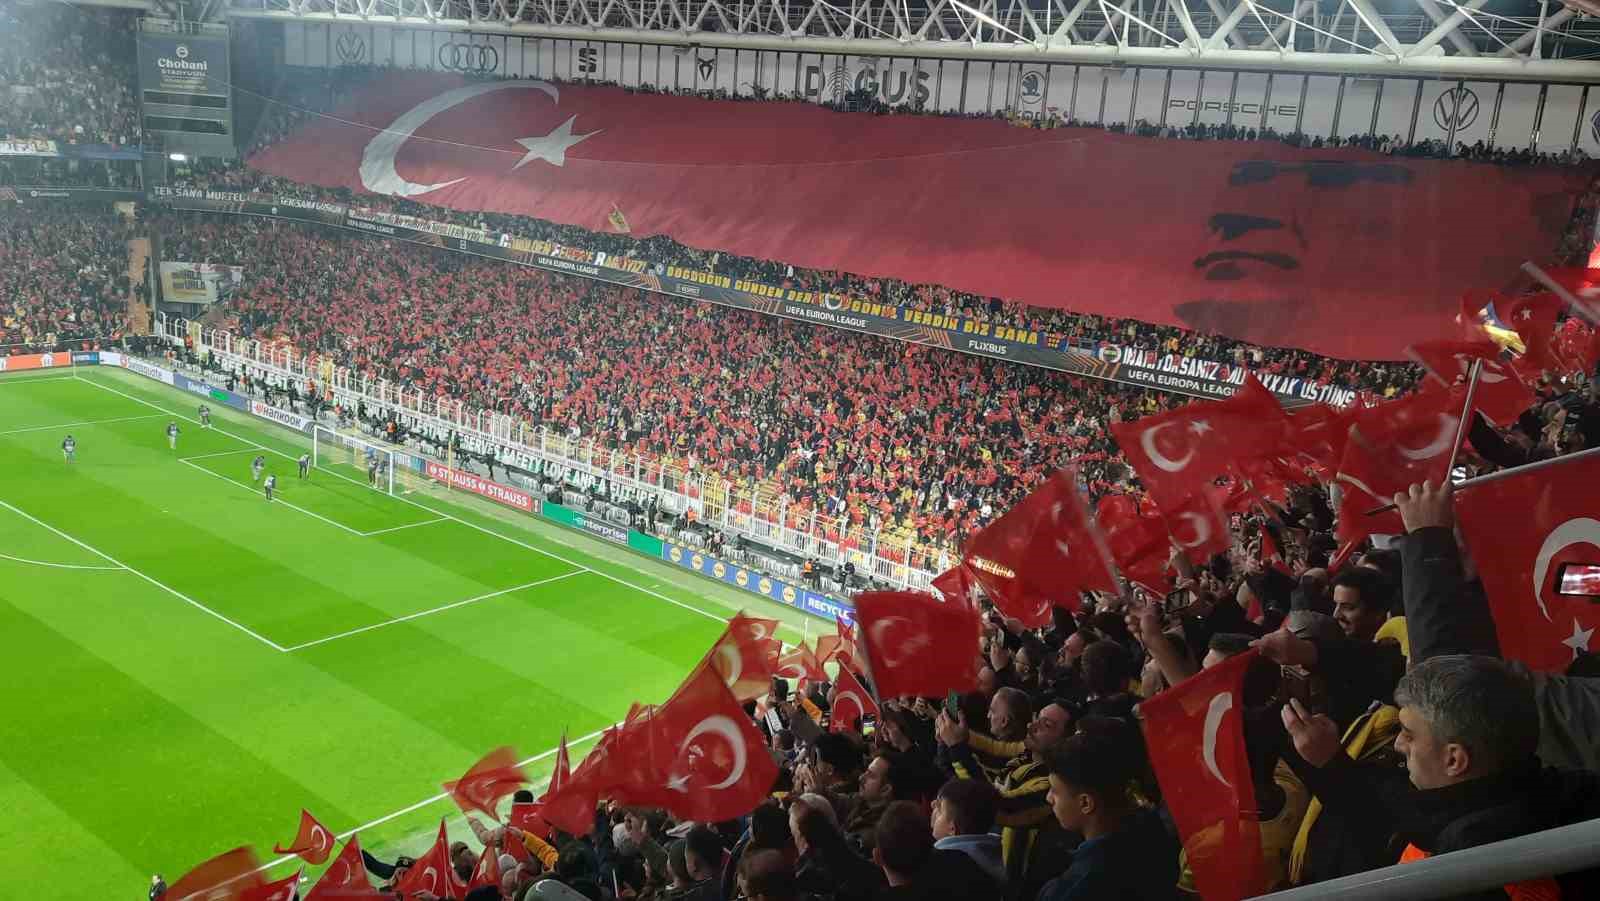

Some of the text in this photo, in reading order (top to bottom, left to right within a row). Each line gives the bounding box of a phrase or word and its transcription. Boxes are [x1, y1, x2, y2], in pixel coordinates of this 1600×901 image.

[158, 57, 207, 71] Chobani
[1168, 98, 1299, 117] PORSCHE
[785, 305, 867, 329] UEFA EUROPA LEAGUE
[994, 325, 1038, 345] SANA
[1128, 369, 1155, 383] UEFA
[1157, 374, 1201, 391] EUROPA
[502, 446, 544, 474] SAFETY
[543, 460, 571, 483] LOVE
[487, 486, 529, 507] STRAUSS
[808, 597, 850, 620] RECYCLE
